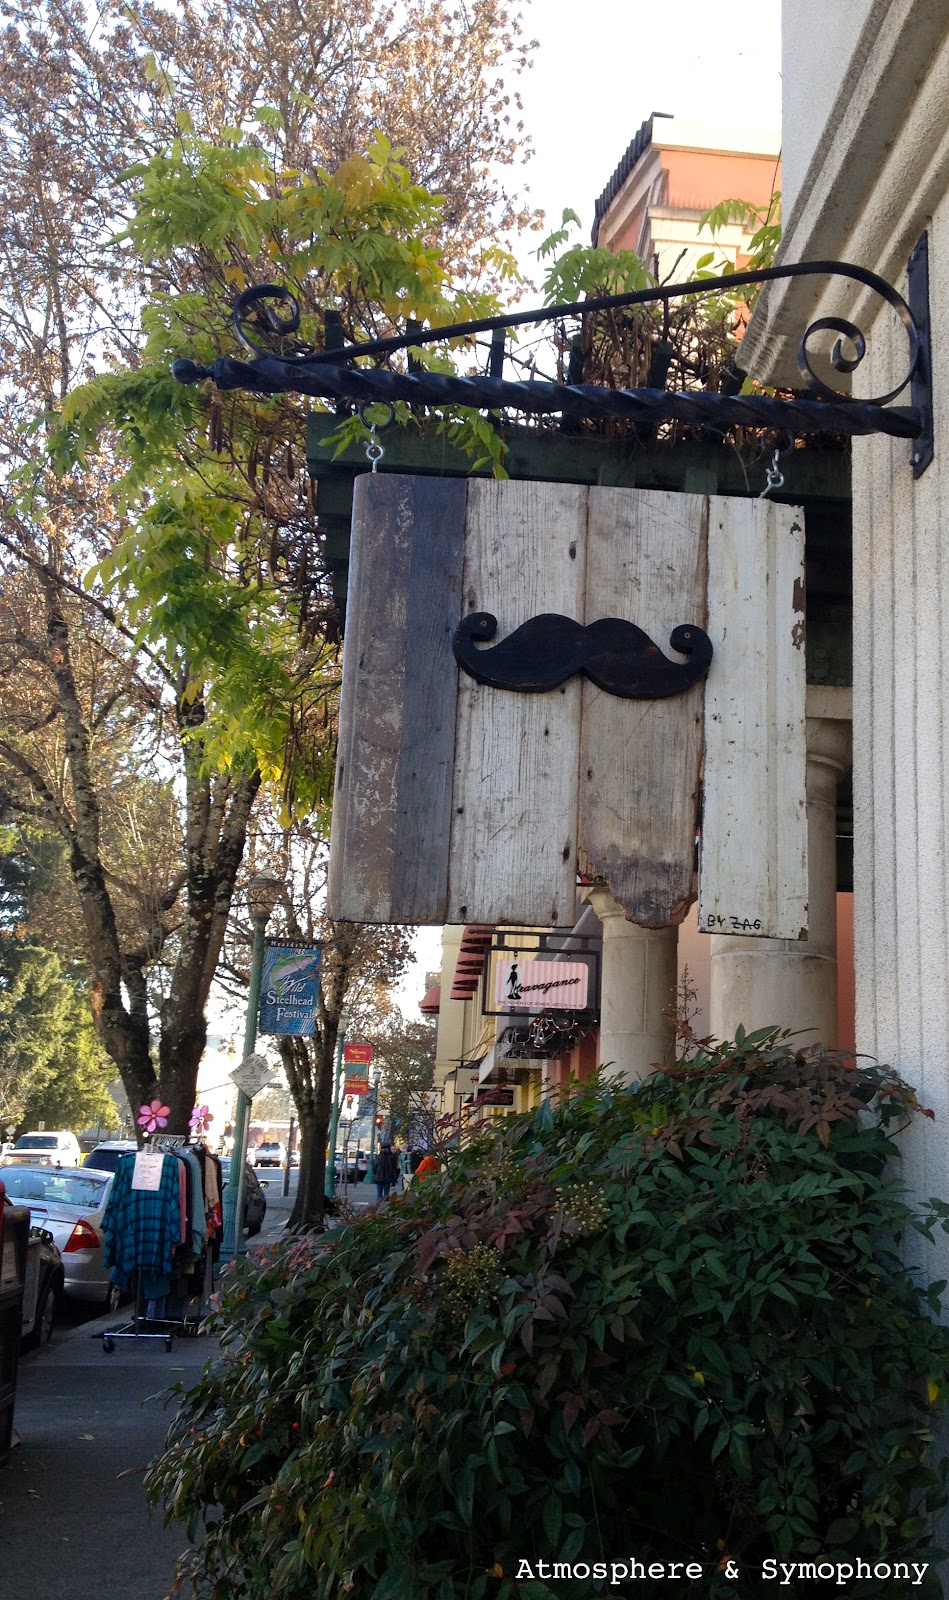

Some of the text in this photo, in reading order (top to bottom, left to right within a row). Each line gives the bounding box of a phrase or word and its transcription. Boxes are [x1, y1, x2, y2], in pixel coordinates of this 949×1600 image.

[278, 975, 309, 995] Wild
[266, 990, 313, 1006] Steelhead
[276, 1007, 313, 1021] Festival
[232, 1055, 269, 1077] PARKING LIMIT
